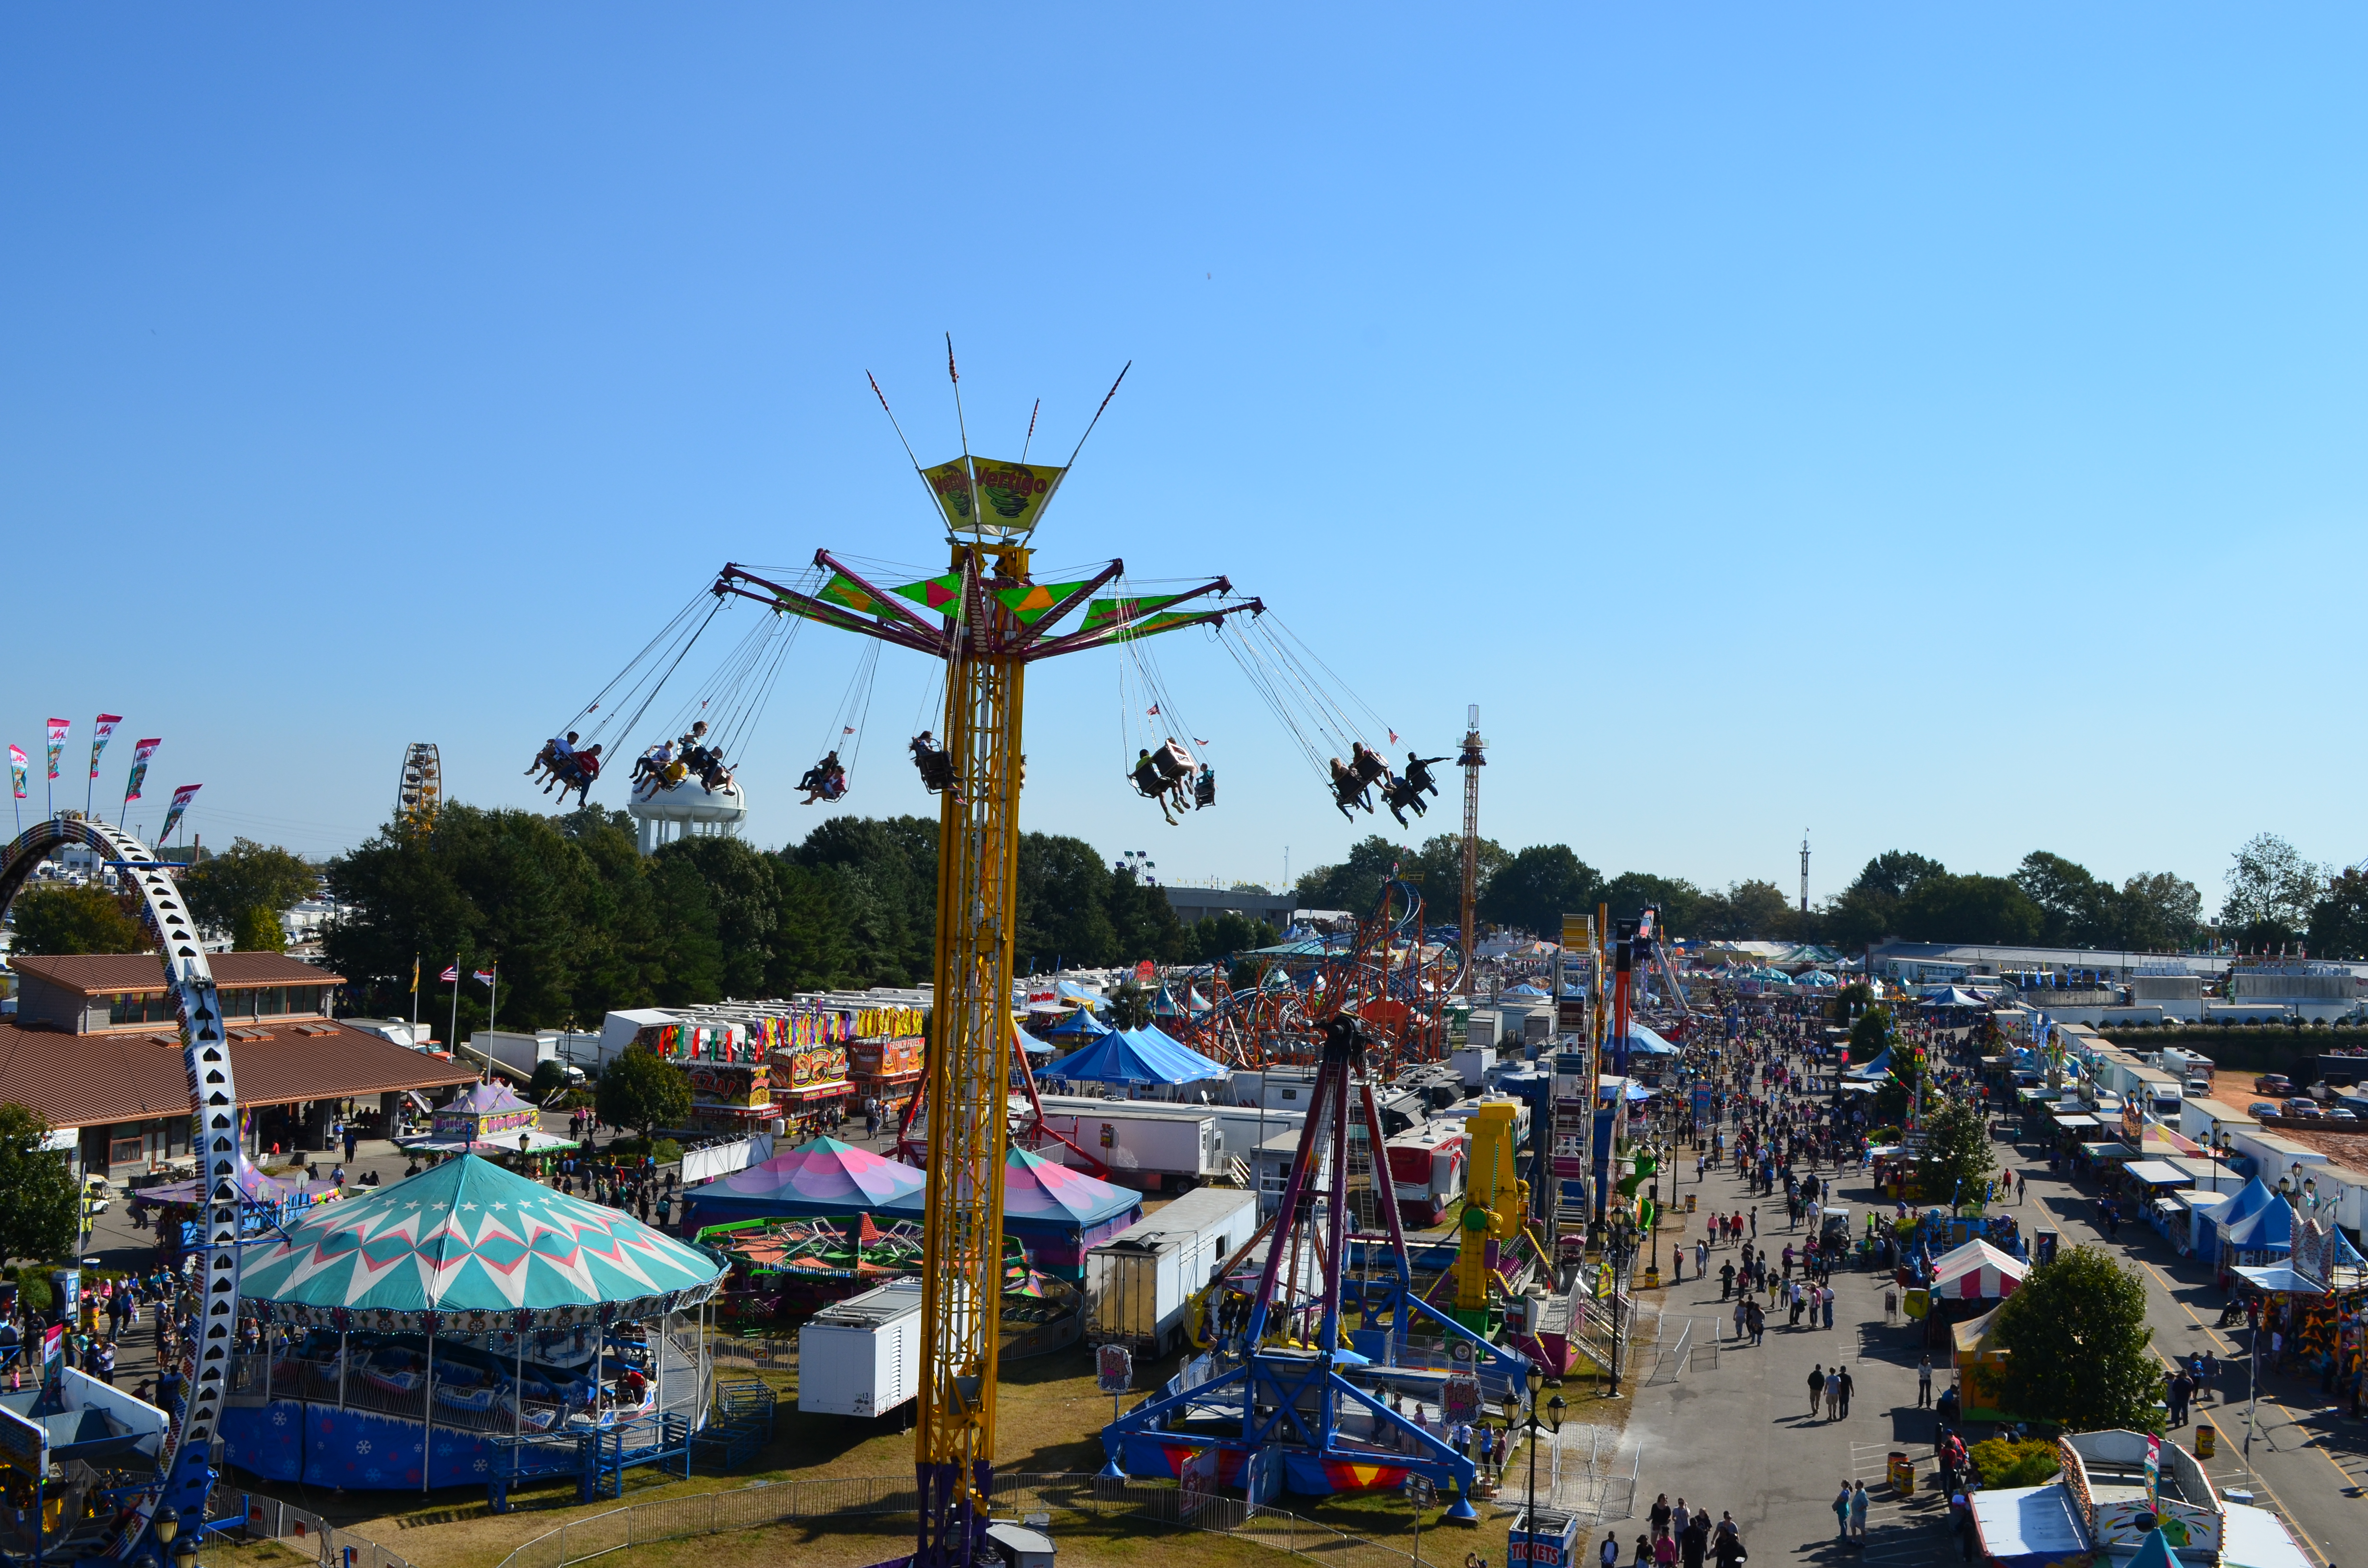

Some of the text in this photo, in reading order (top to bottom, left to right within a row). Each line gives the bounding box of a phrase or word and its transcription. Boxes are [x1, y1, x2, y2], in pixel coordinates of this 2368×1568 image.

[931, 471, 970, 496] Vertig
[975, 466, 1047, 497] Vertigo
[889, 1040, 907, 1051] FRENCH
[773, 1056, 789, 1067] DOGS
[81, 1180, 93, 1233] ATM
[67, 1279, 77, 1314] ATM
[1512, 1543, 1558, 1565] TICKETS
